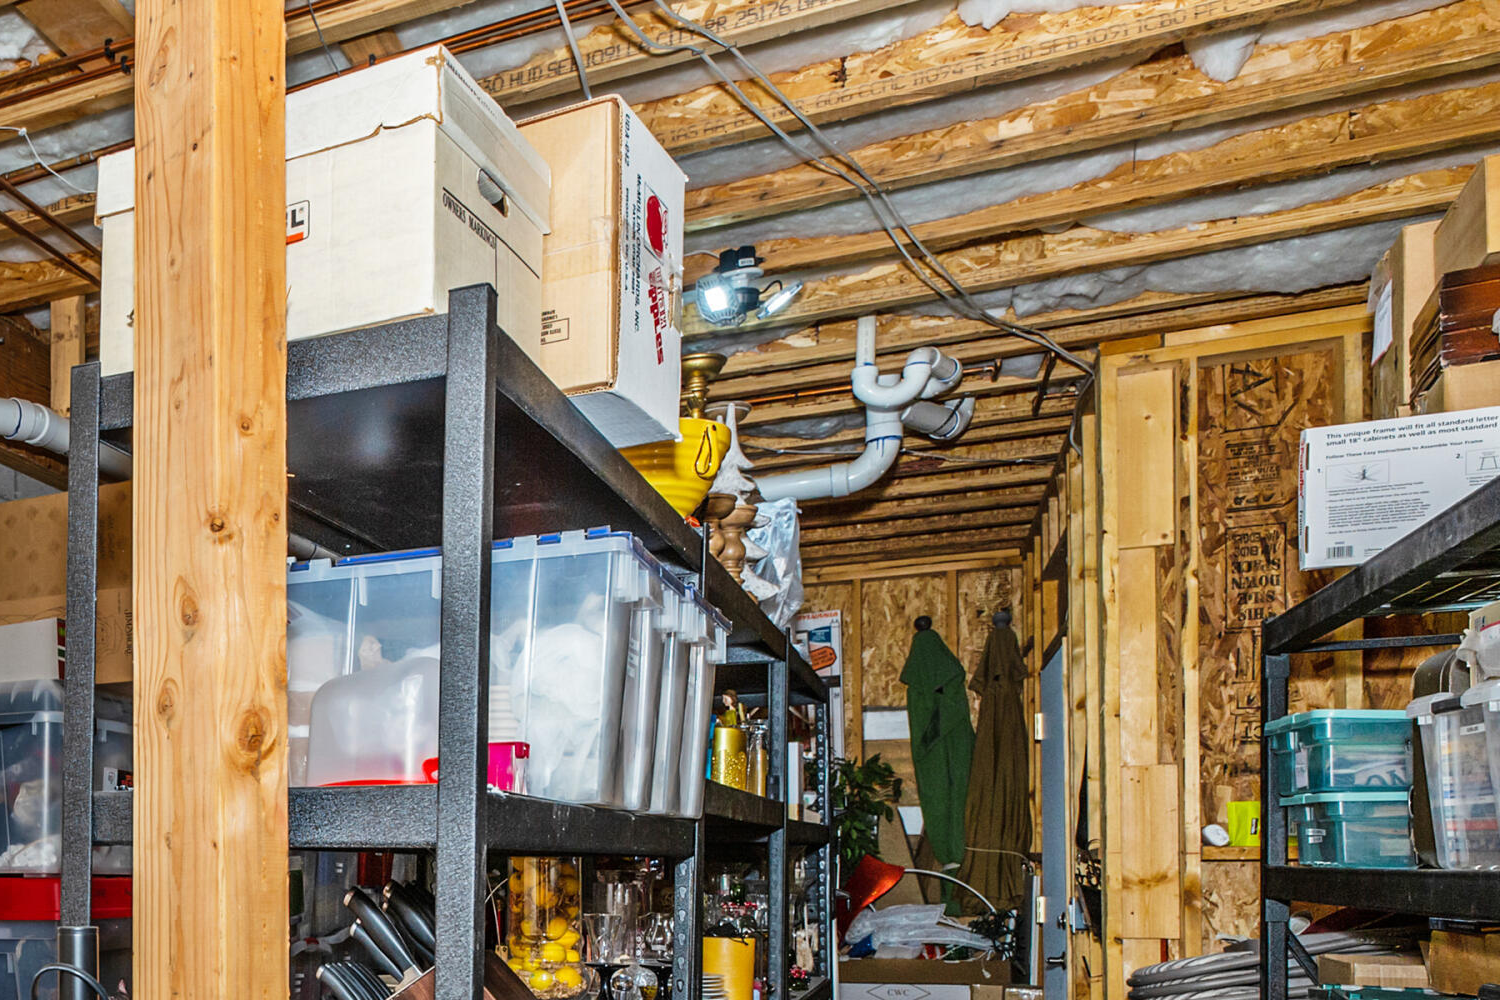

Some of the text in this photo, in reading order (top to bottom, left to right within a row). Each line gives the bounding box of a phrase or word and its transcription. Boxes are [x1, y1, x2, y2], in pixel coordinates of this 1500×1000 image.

[442, 192, 467, 225] OWNERS
[1326, 438, 1347, 447] small
[1363, 433, 1396, 443] cabinets
[1408, 430, 1426, 438] well
[1438, 426, 1459, 434] most
[1460, 421, 1498, 431] standard
[1343, 430, 1371, 440] unique
[1373, 426, 1396, 435] frame
[1398, 424, 1413, 432] will
[1437, 417, 1474, 427] standard
[1475, 414, 1499, 424] letter
